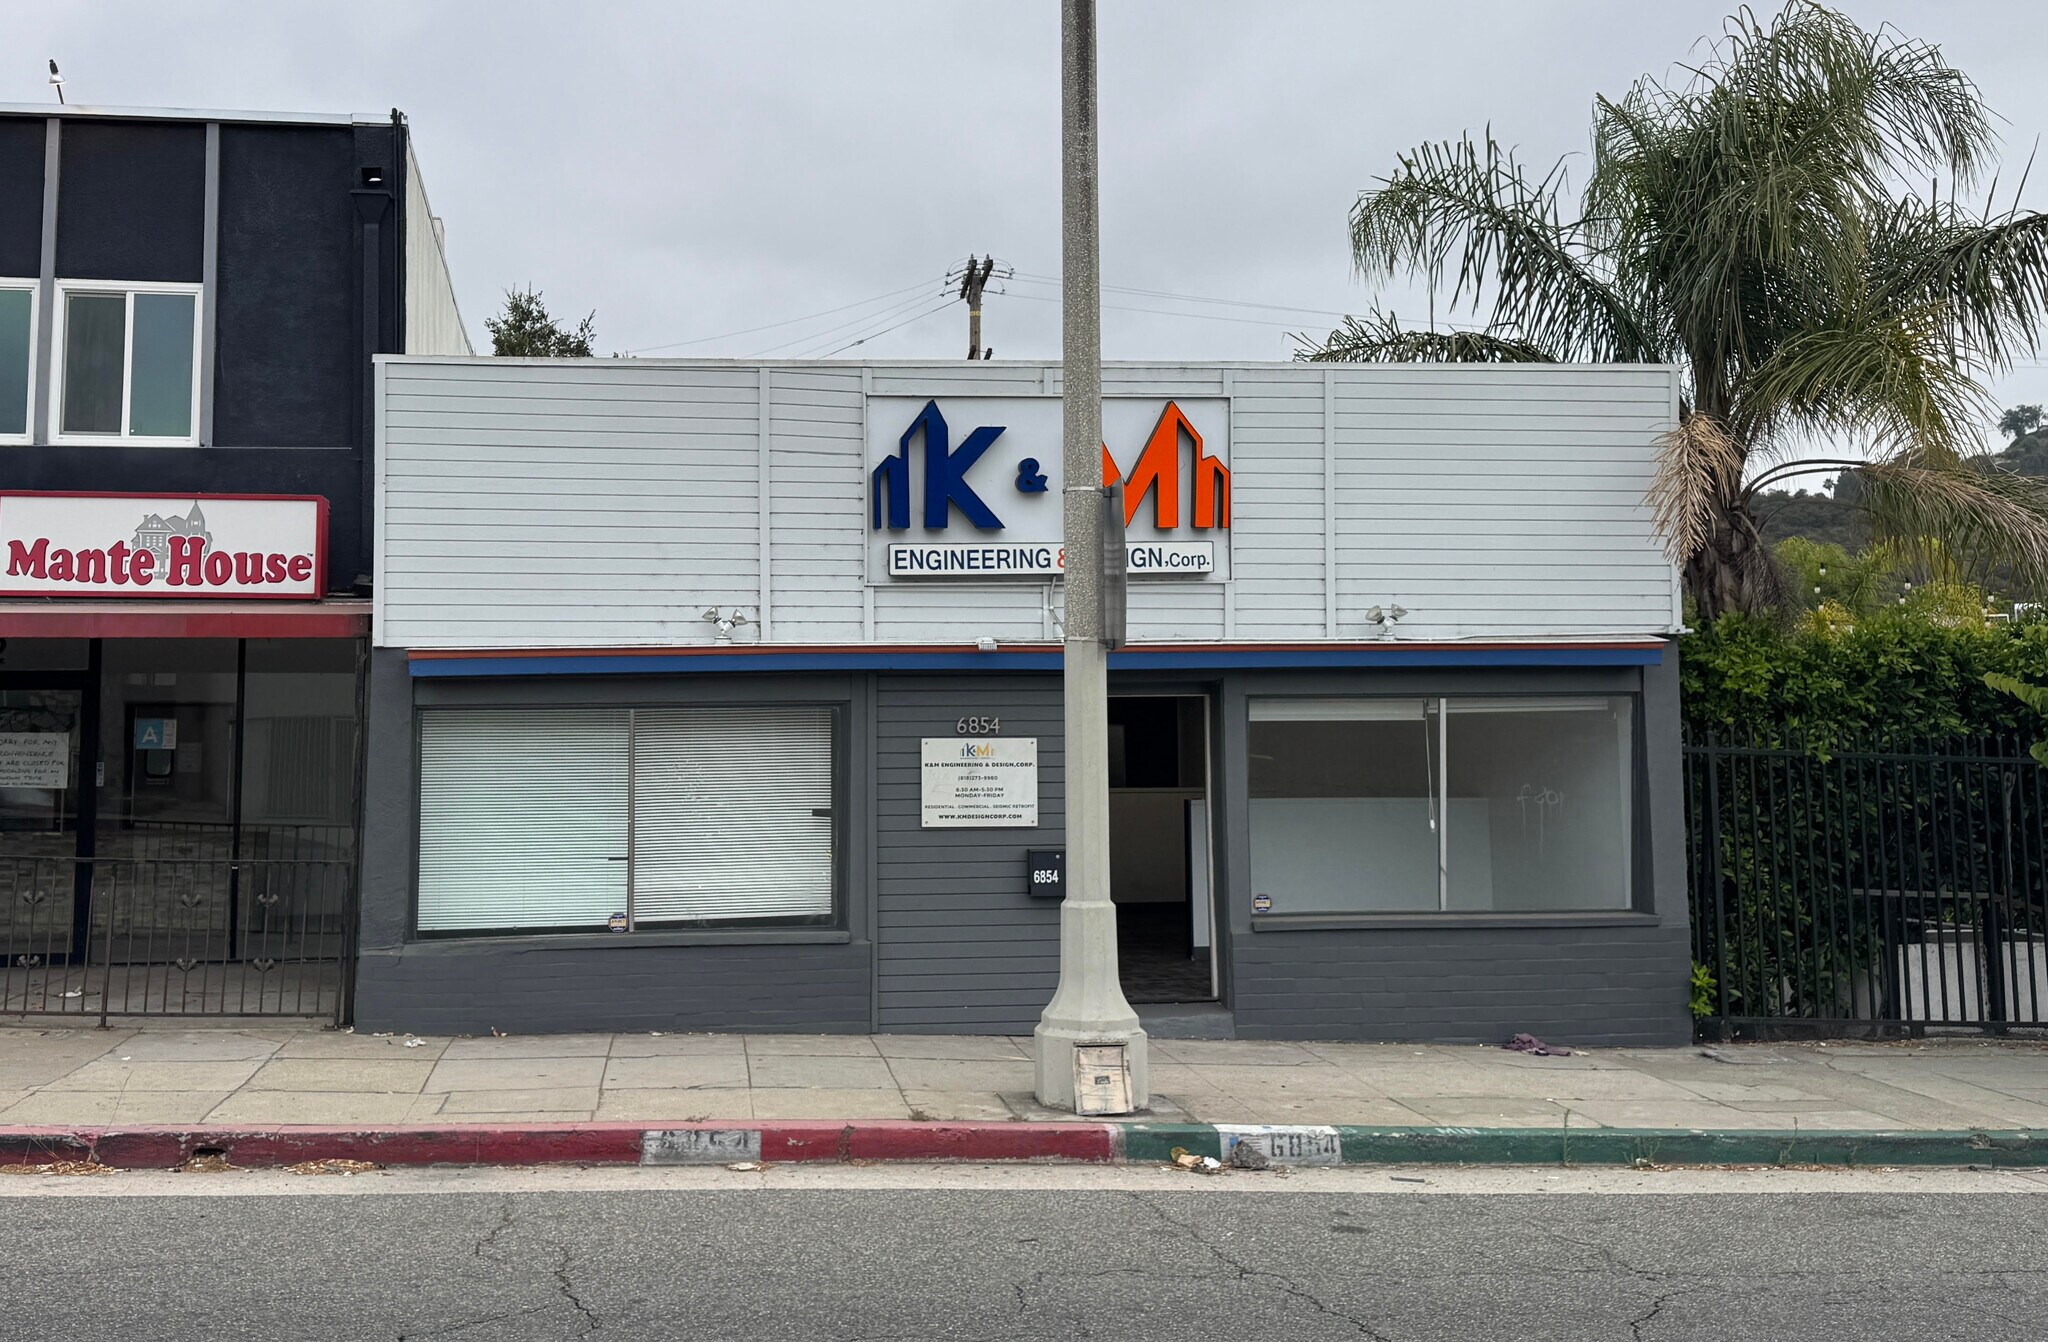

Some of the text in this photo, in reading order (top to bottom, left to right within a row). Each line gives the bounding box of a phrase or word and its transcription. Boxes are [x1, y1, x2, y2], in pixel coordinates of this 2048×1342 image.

[898, 399, 1006, 528] K
[1015, 457, 1049, 493] &
[6, 536, 312, 586] Mante House
[893, 548, 1052, 571] ENGINEERING
[142, 726, 158, 743] A
[956, 717, 1001, 734] 6854
[1033, 870, 1059, 883] 6854
